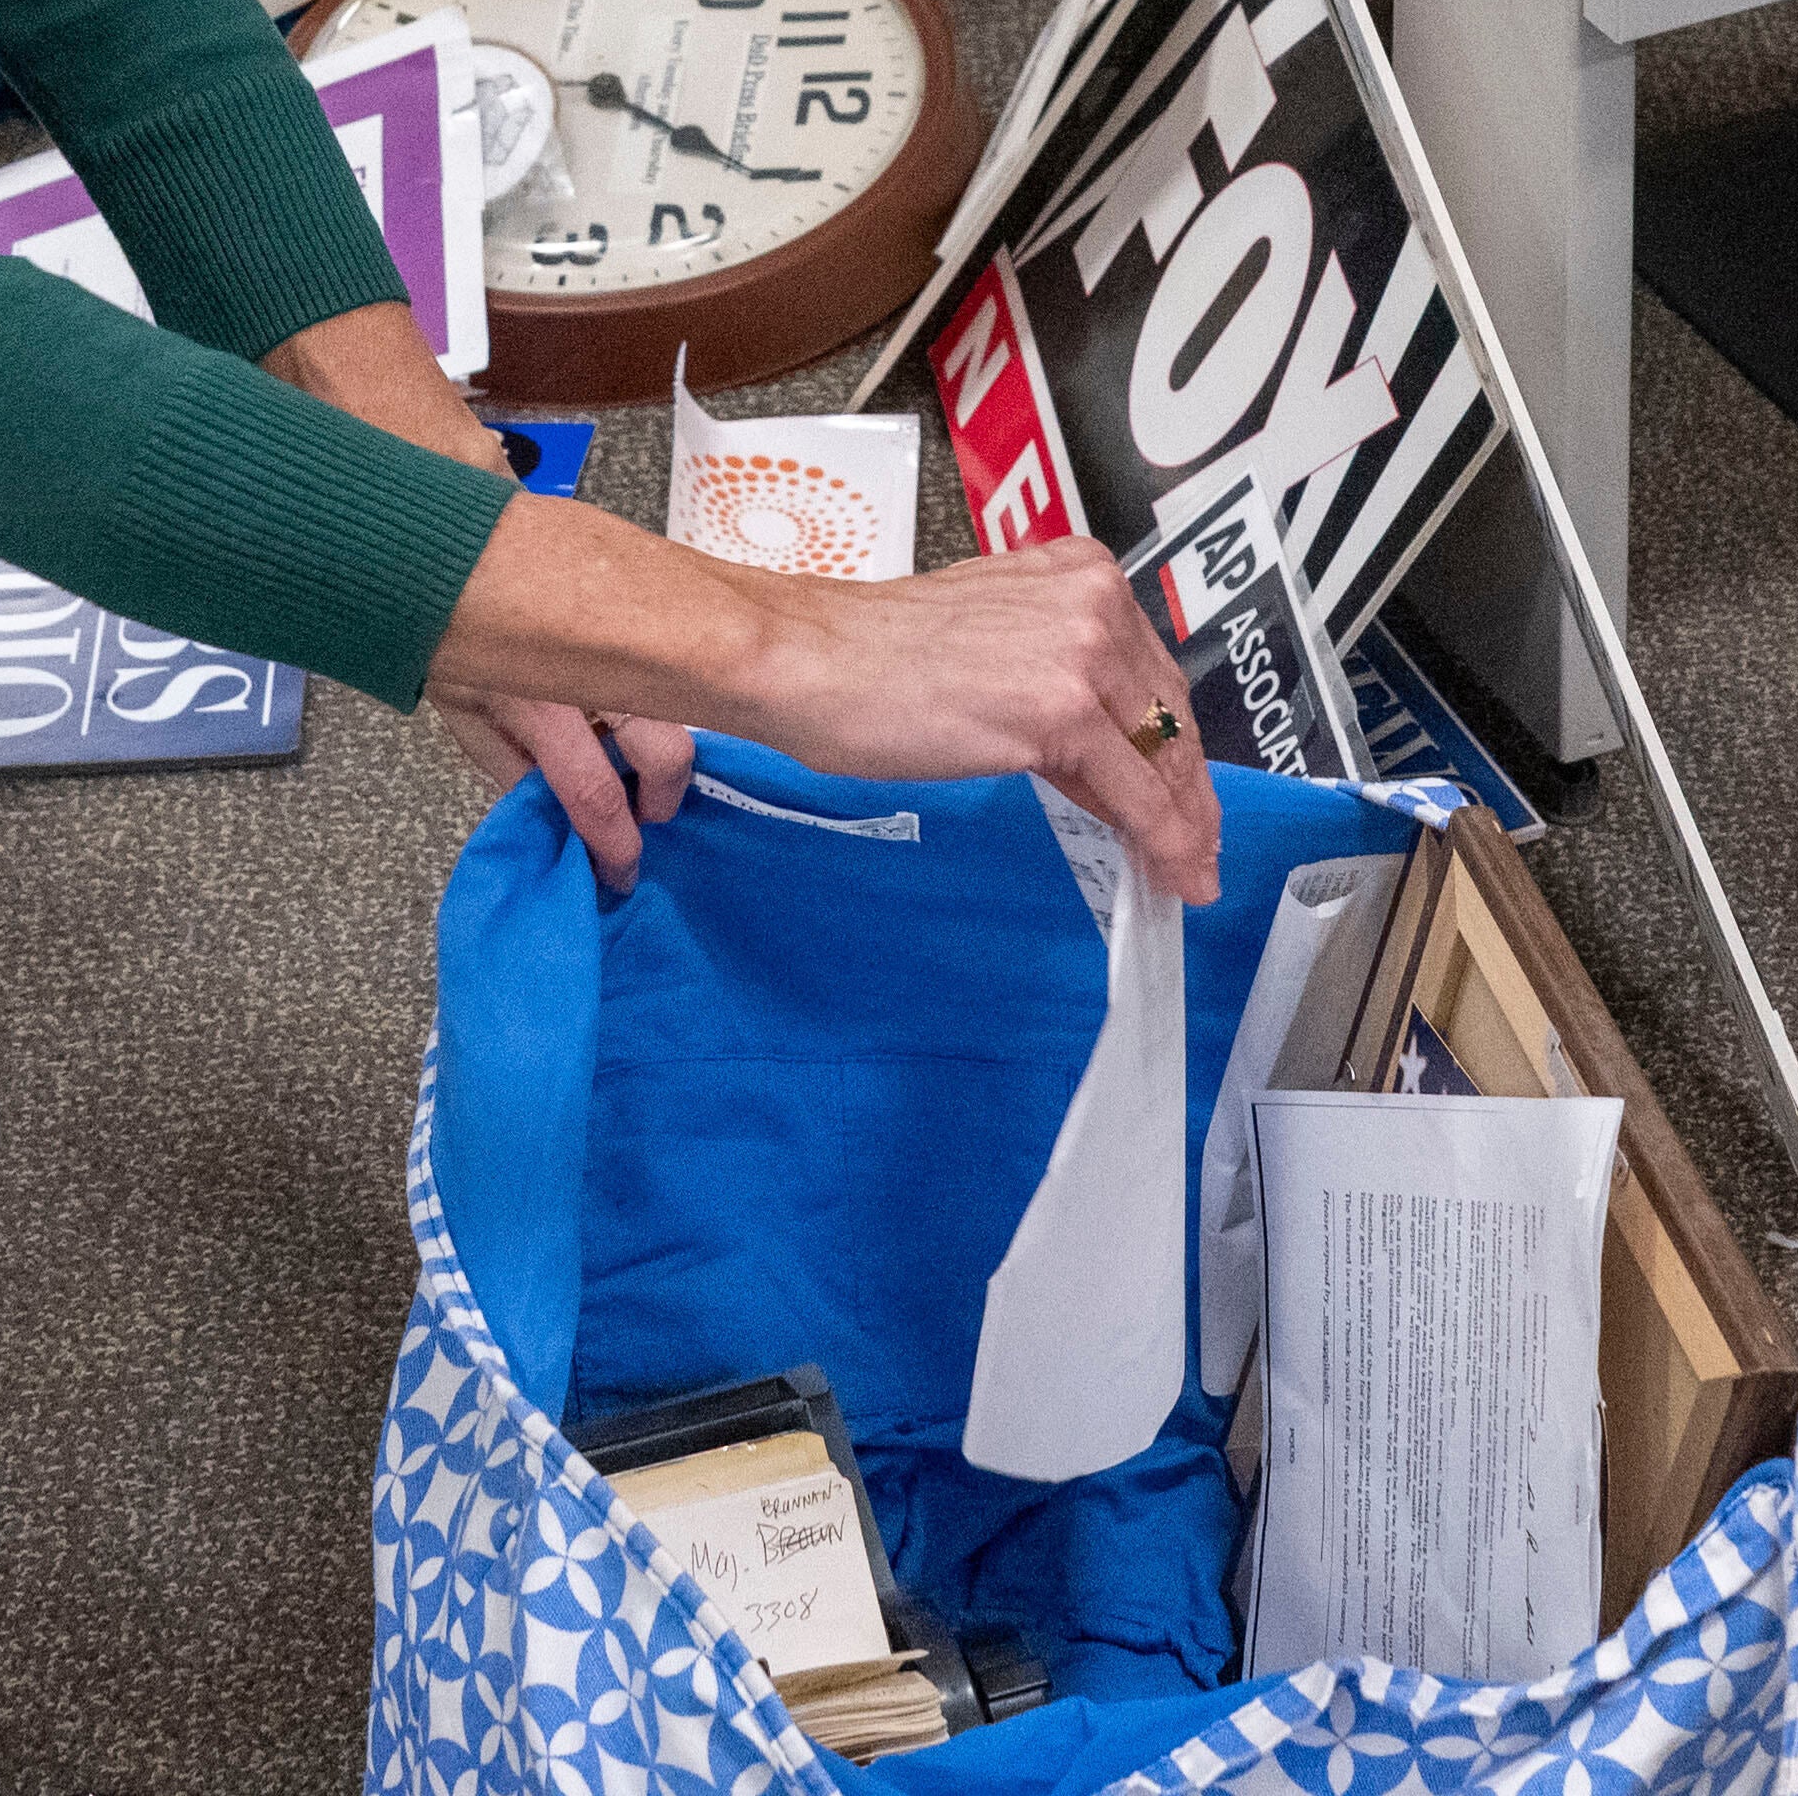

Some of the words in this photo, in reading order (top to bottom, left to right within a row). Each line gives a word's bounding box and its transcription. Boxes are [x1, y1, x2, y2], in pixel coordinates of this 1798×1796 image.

[777, 11, 850, 48] 11
[738, 70, 766, 109] Press
[796, 71, 872, 126] 12
[530, 223, 608, 266] 3
[648, 204, 726, 245] 2
[1073, 4, 1400, 542] FOX
[1194, 517, 1256, 590] AP
[1221, 607, 1309, 779] ASSOCIAT
[691, 1541, 750, 1592] Maj.
[745, 1587, 819, 1634] 3308
